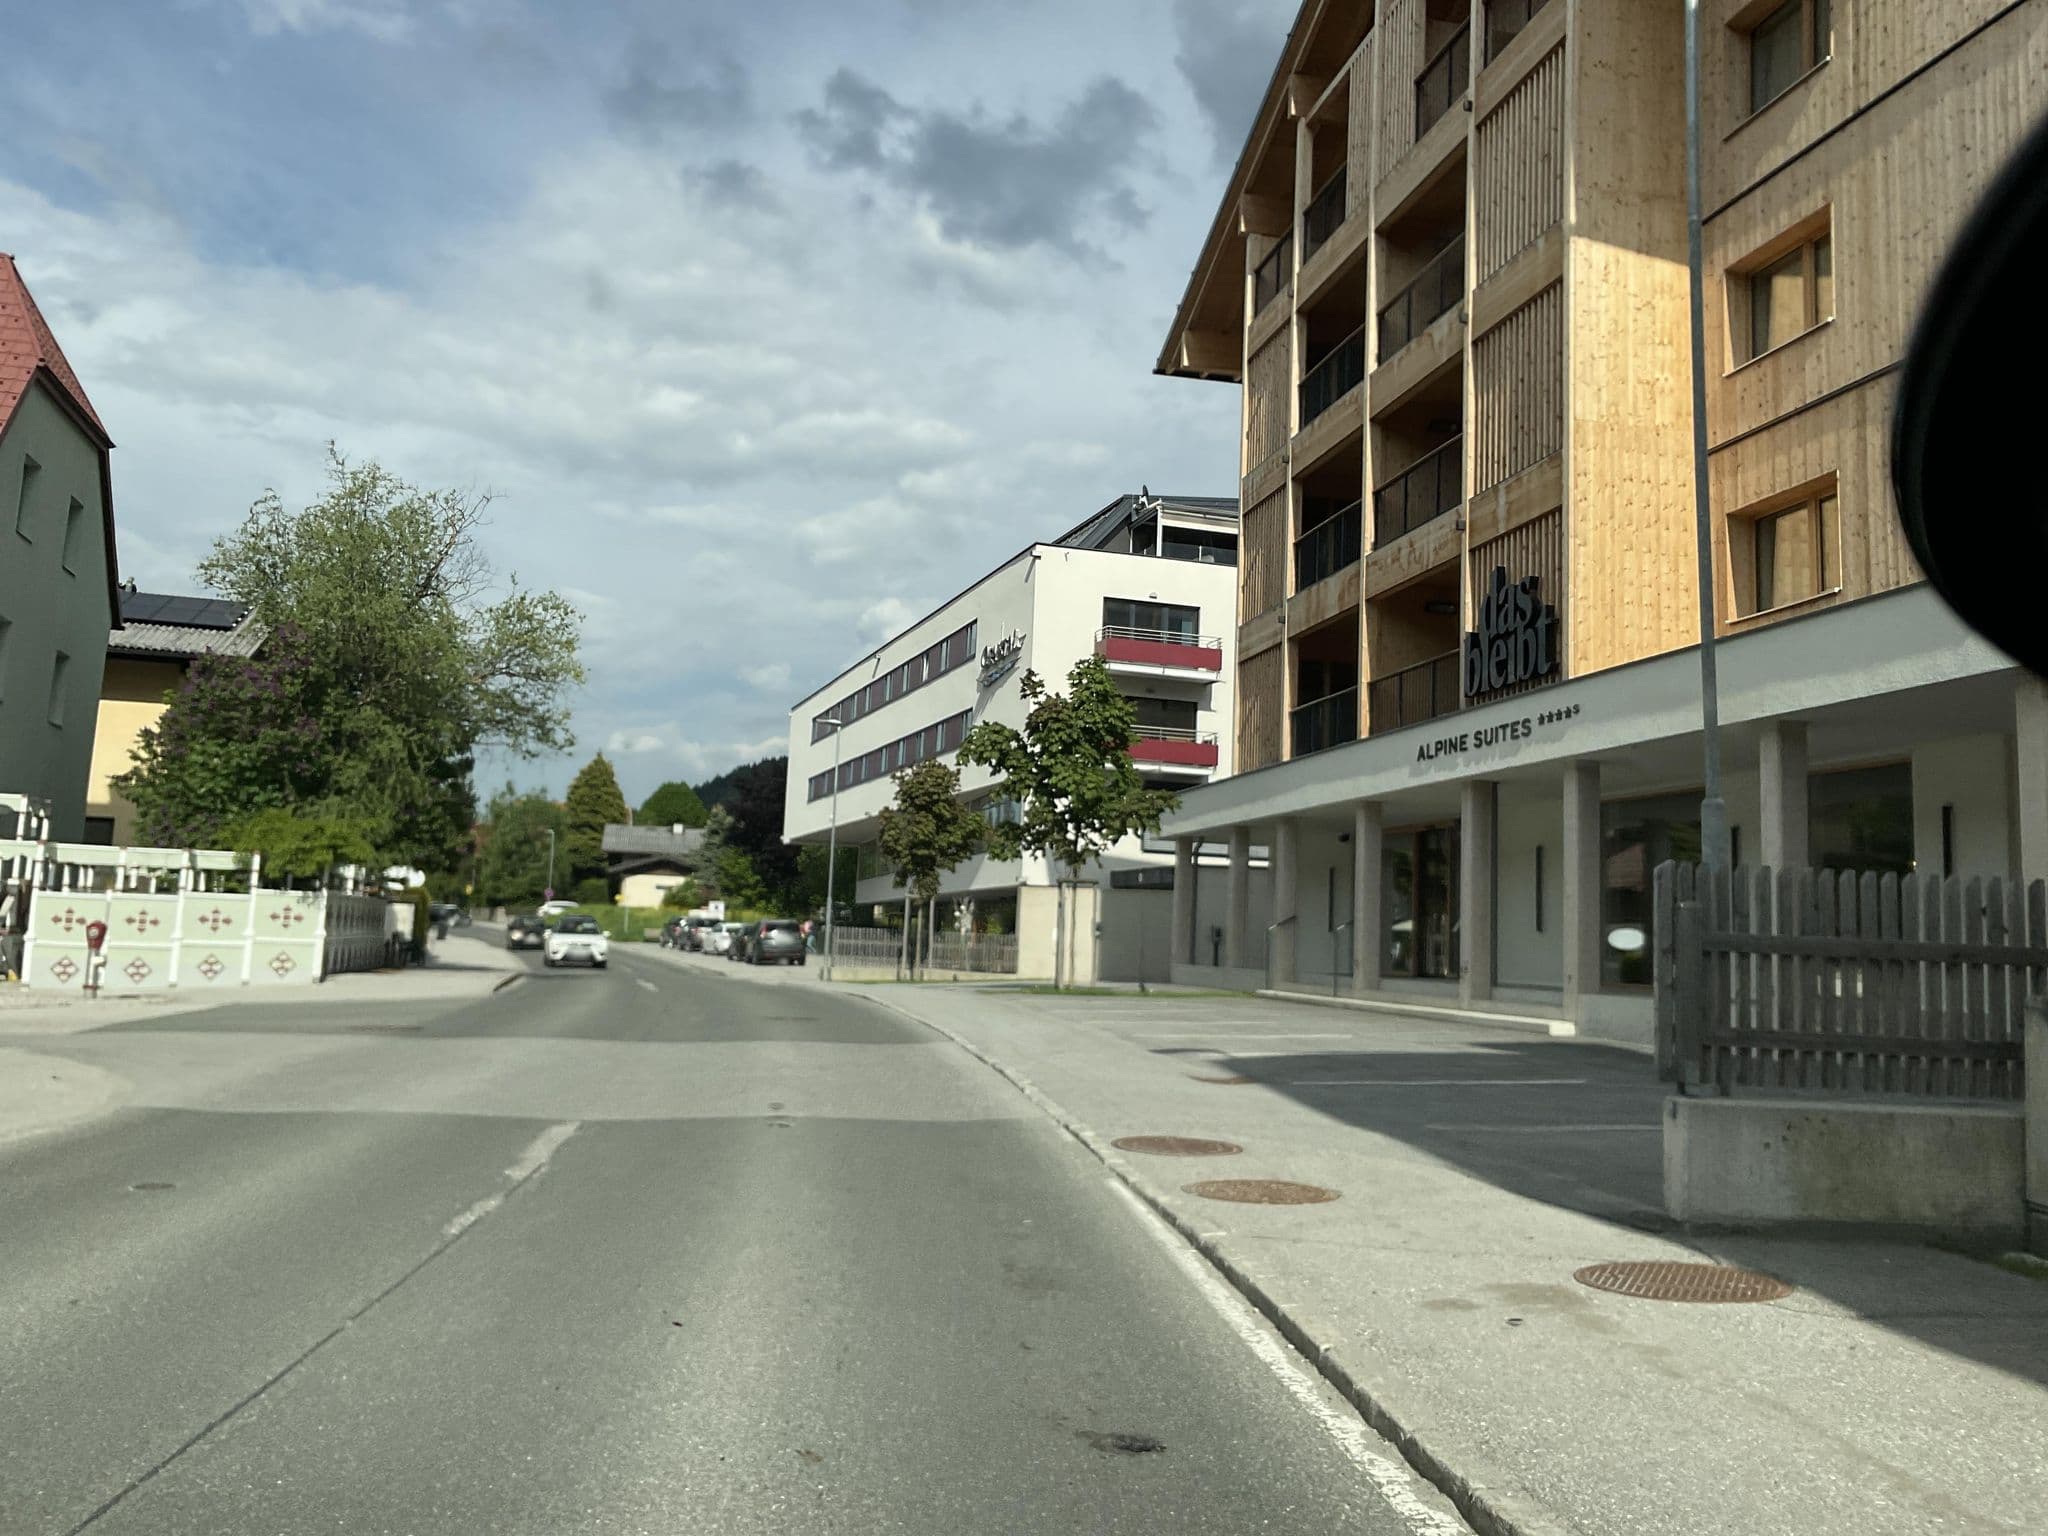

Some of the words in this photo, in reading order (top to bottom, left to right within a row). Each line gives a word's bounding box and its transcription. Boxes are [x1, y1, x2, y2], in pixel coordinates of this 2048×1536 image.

[1481, 566, 1539, 634] das
[1464, 603, 1557, 698] bleibt
[1416, 734, 1469, 762] ALPINE
[1473, 718, 1532, 748] SUITES
